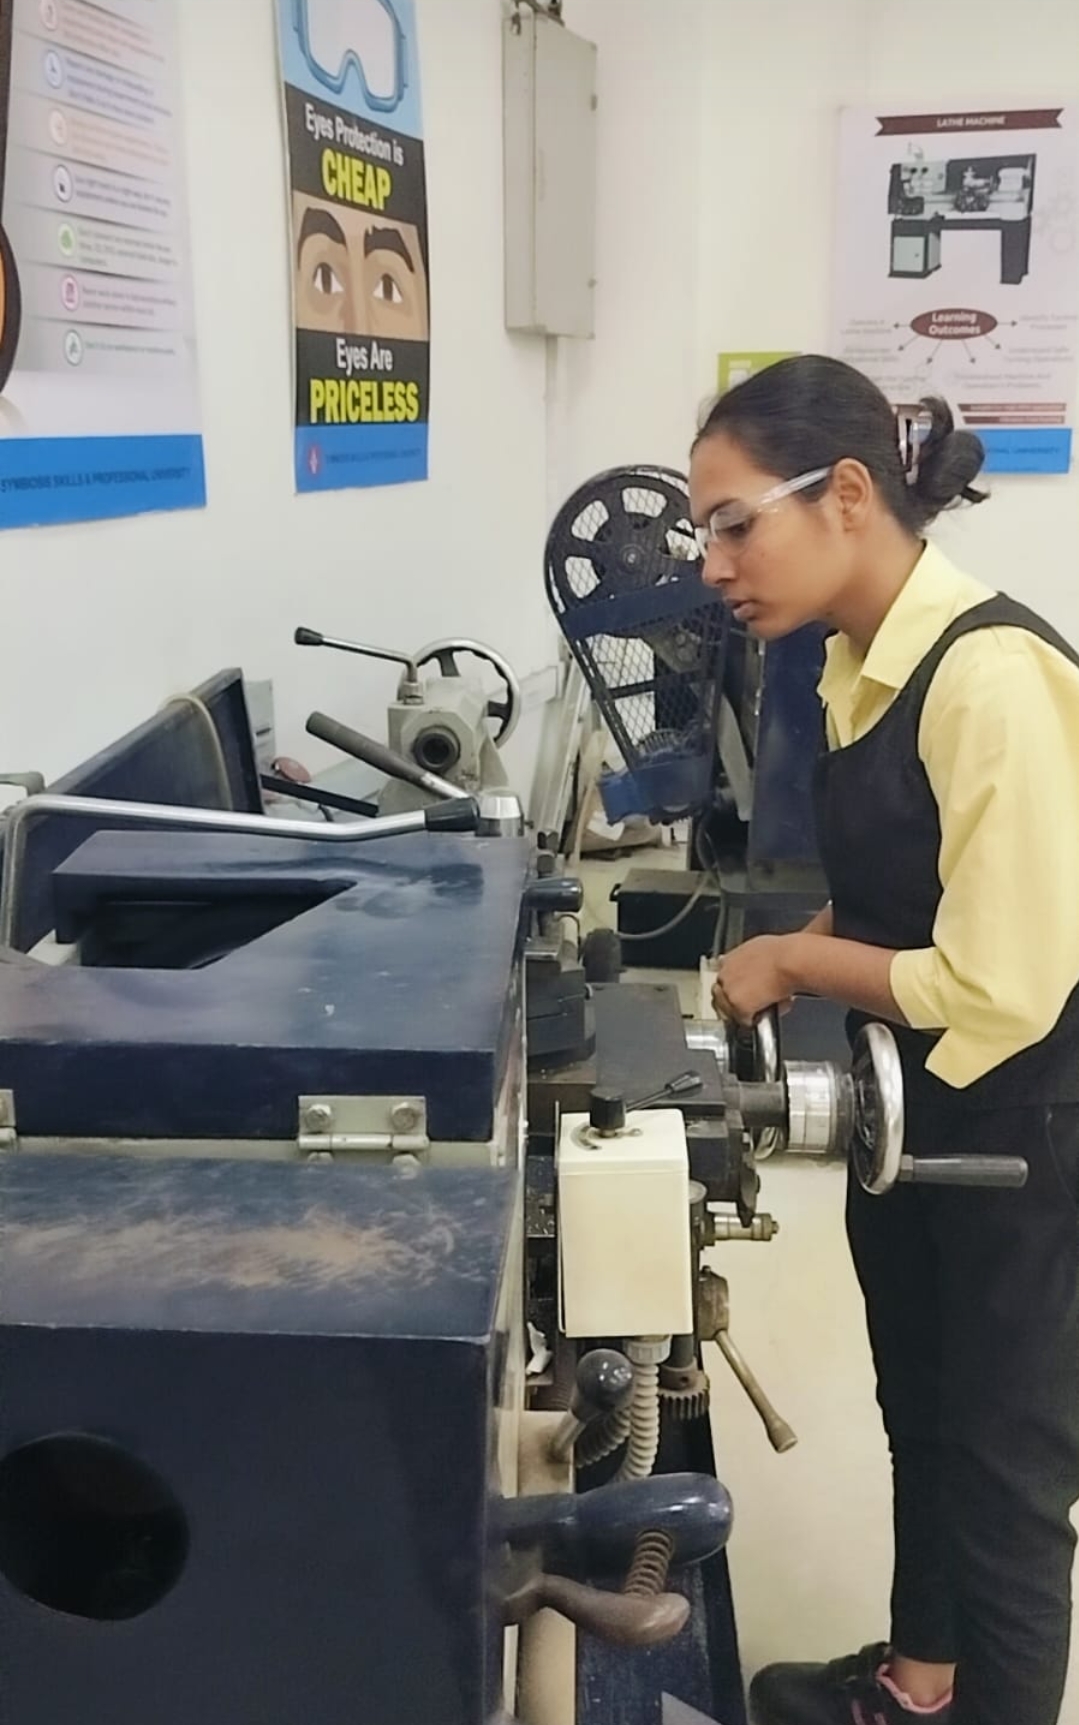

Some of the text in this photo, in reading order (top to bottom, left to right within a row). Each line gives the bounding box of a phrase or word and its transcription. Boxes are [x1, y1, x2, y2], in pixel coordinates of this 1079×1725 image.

[305, 102, 405, 167] Eyes Protection is
[937, 115, 1004, 128] LATHE MACHINE
[322, 148, 392, 211] CHEAP
[928, 324, 981, 335] Outcomes
[931, 311, 977, 324] Learning
[336, 337, 393, 376] Eyes Are
[310, 379, 419, 424] PRICELESS
[53, 473, 82, 487] SKILLS
